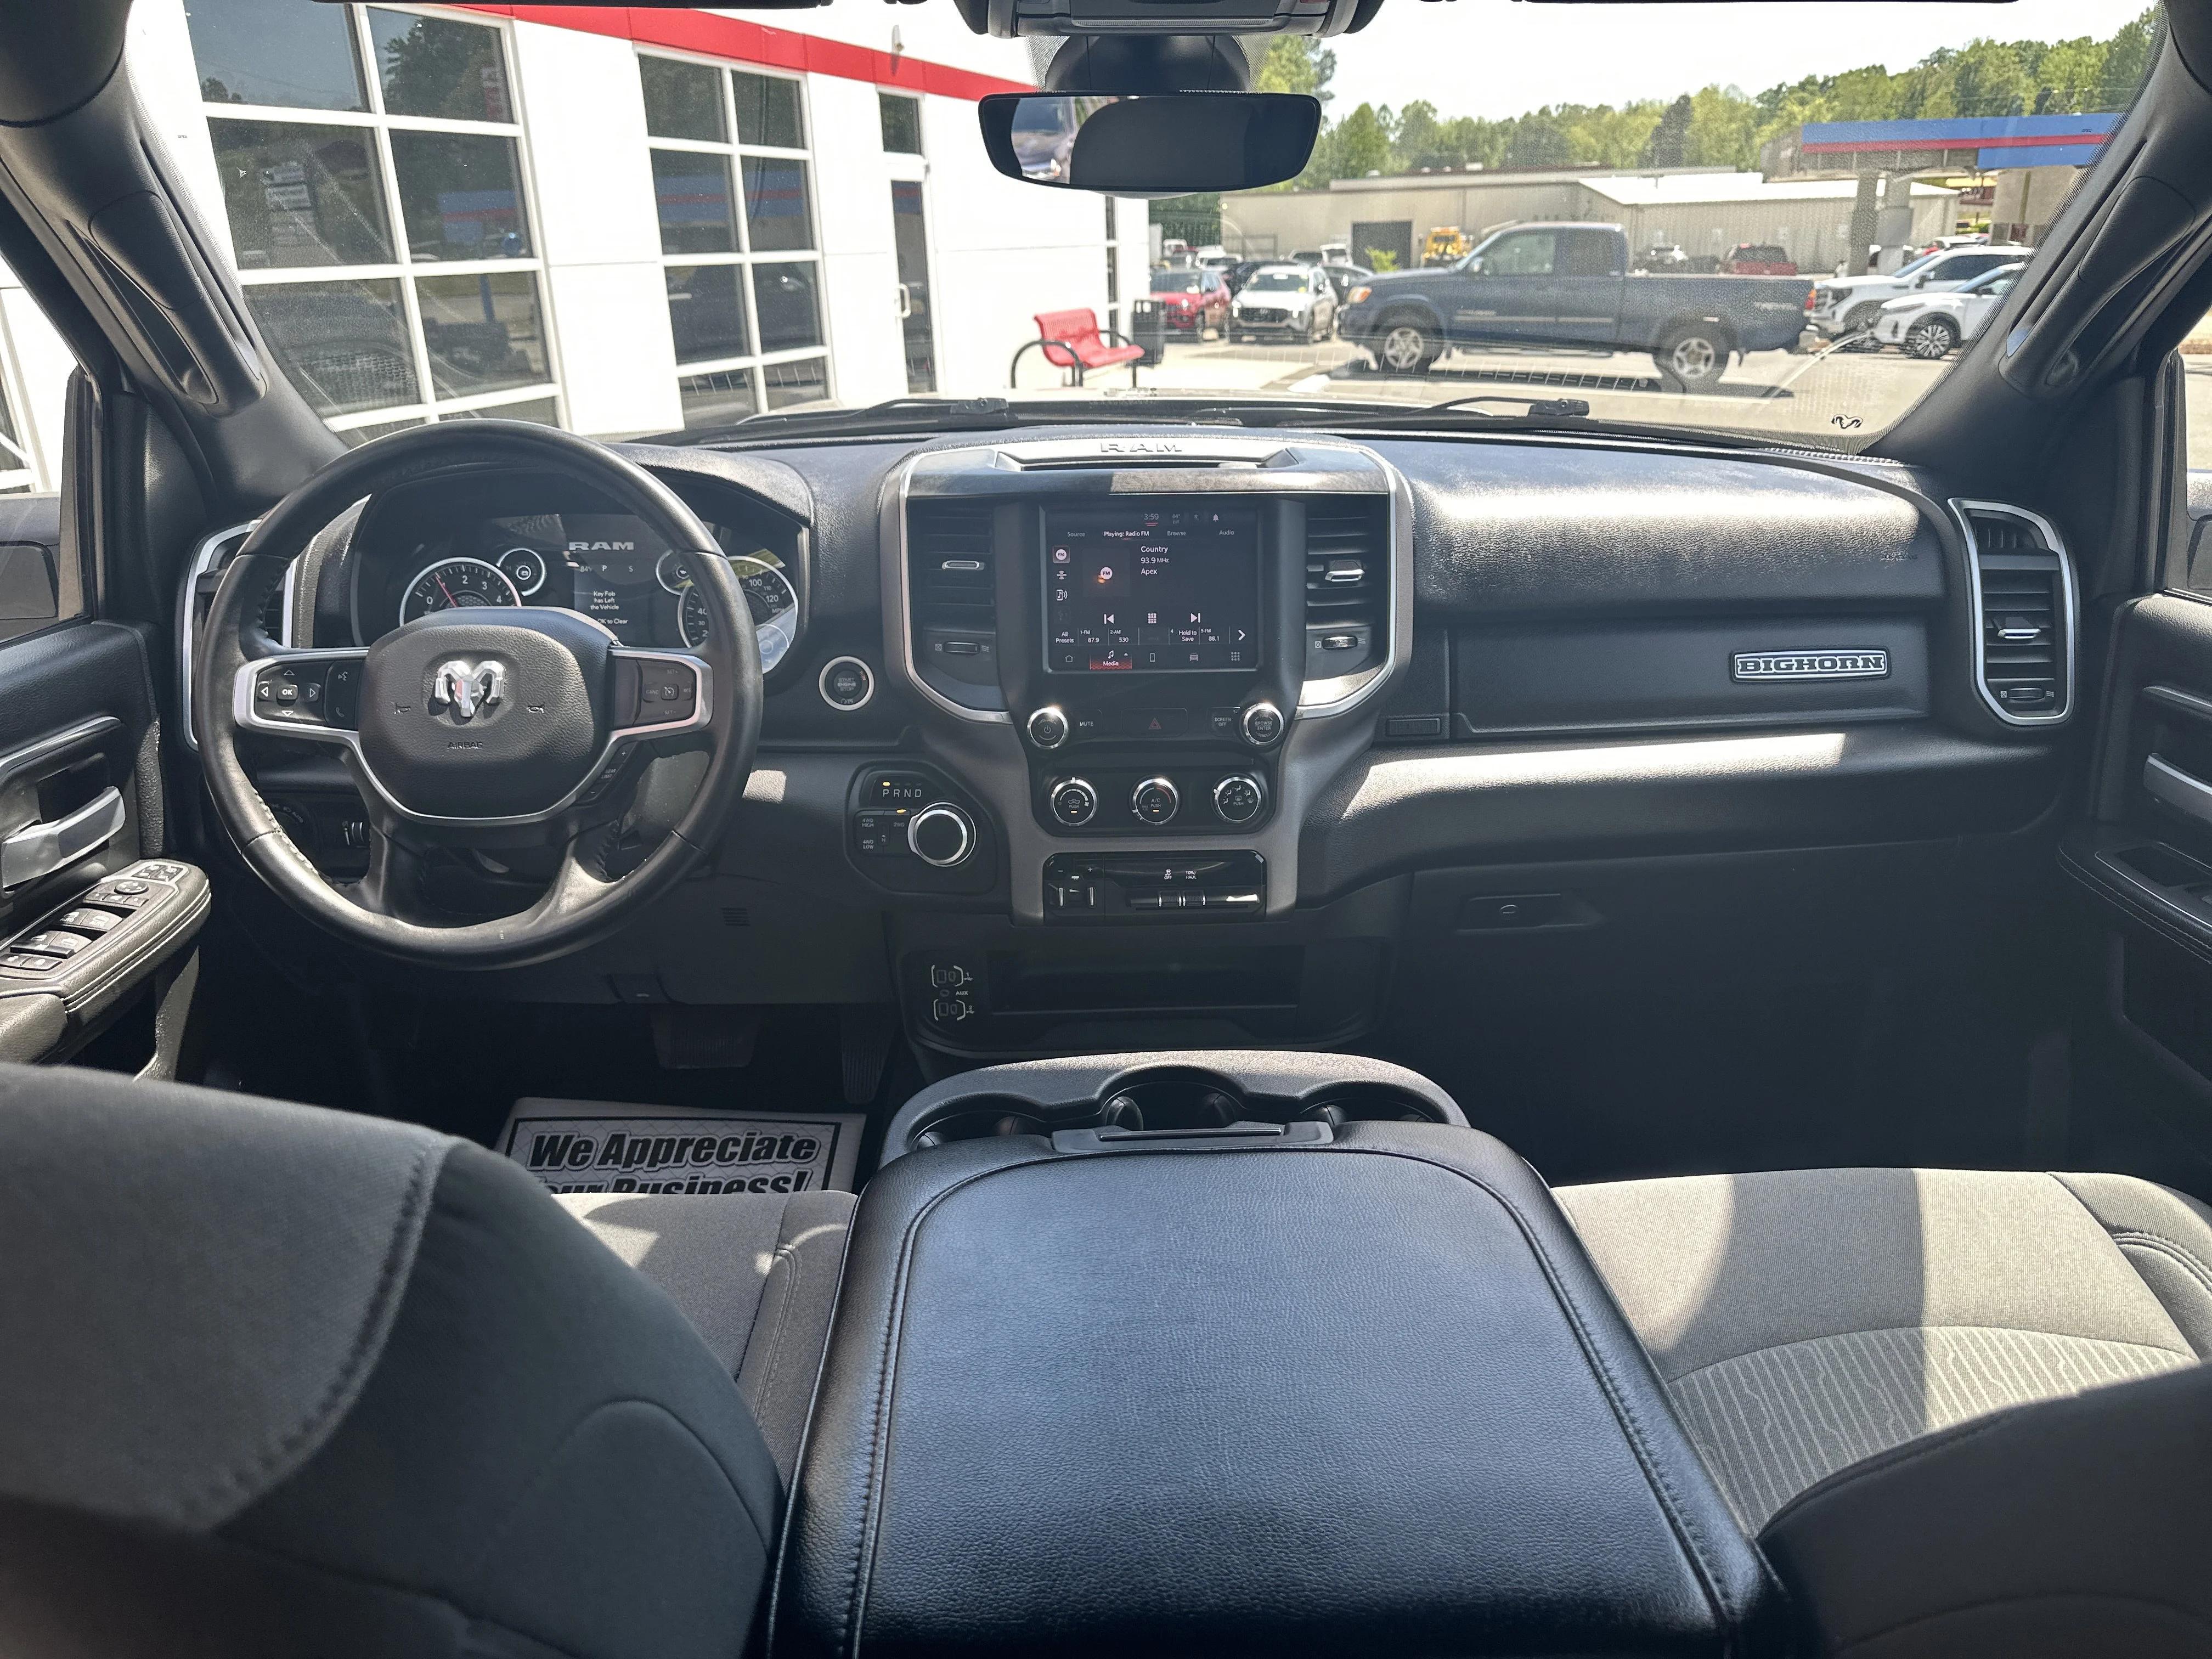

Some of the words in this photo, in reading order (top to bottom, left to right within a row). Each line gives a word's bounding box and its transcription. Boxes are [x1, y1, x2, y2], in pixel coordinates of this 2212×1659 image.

[1101, 443, 1182, 452] RAM
[569, 541, 634, 550] RAM
[426, 596, 433, 605] 0
[462, 575, 468, 584] 2
[482, 582, 488, 590] 3
[749, 579, 763, 587] 100
[766, 594, 779, 603] 120
[1736, 656, 1884, 674] BIGHORN
[882, 789, 889, 797] P
[893, 789, 900, 798] R
[904, 789, 911, 798] N
[915, 789, 922, 798] D
[530, 1134, 594, 1167] We
[596, 1132, 817, 1168] Appreciate
